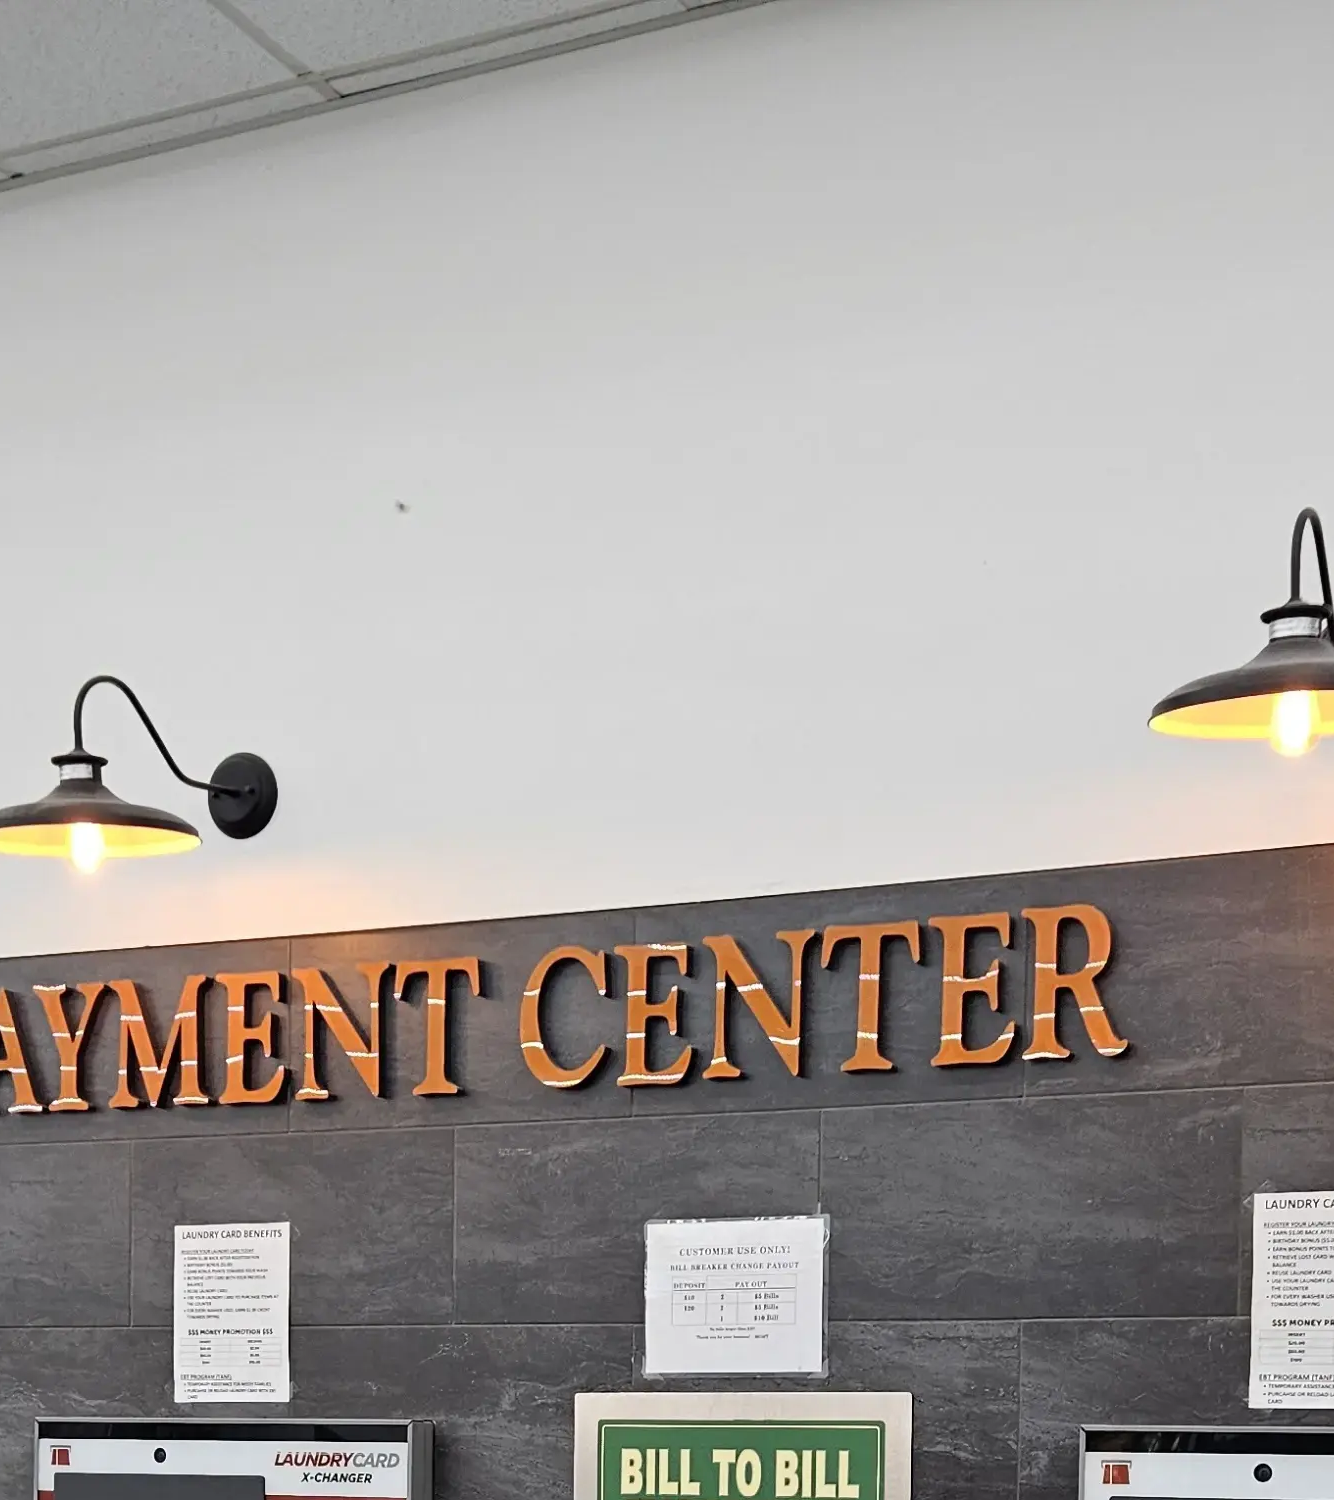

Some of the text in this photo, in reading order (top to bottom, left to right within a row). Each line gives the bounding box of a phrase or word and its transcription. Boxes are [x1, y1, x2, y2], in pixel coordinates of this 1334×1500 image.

[521, 902, 1131, 1089] CENTER
[1265, 1199, 1320, 1209] LAUNDRY
[182, 1229, 282, 1239] LAUNDRY CARD BENEFITS
[680, 1248, 734, 1256] CUSTOMER
[760, 1246, 790, 1254] ONLY!
[1272, 1319, 1287, 1327] $$$
[274, 1451, 400, 1468] LAUNDRYCARD
[301, 1472, 372, 1484] X-CHANGER
[620, 1448, 860, 1500] BILL TO BILL
